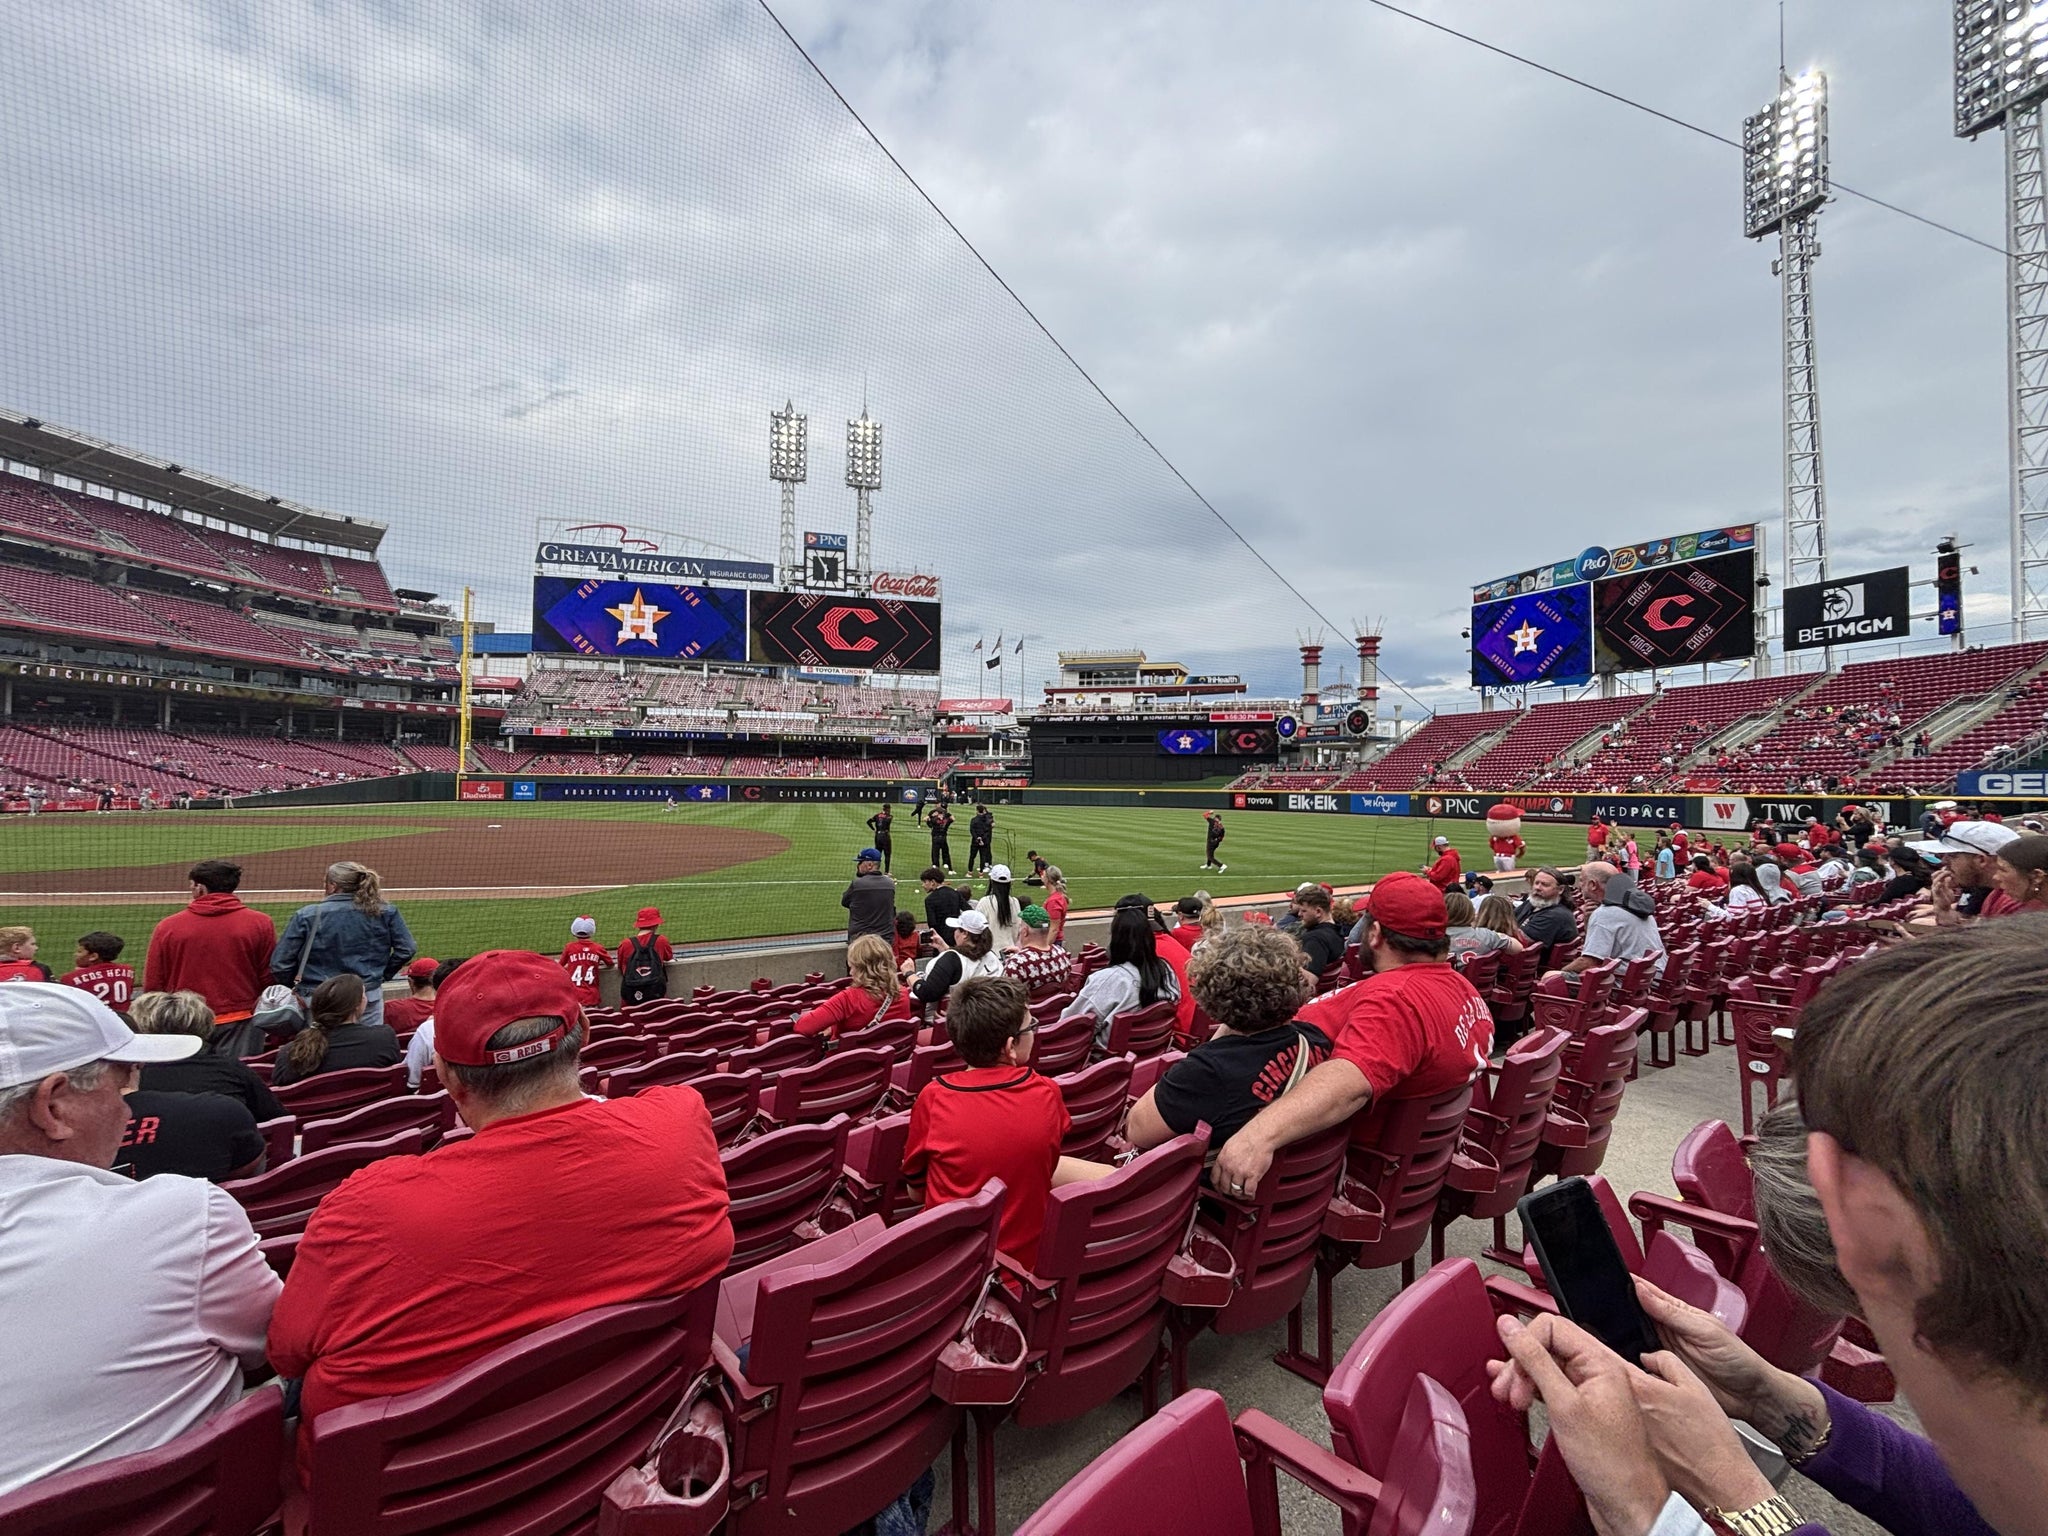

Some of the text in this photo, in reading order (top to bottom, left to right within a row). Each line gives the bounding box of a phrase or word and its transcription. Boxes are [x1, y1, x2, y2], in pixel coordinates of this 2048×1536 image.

[820, 535, 846, 547] PNC
[541, 544, 611, 564] GREAT
[710, 570, 746, 578] INSURANCE
[748, 572, 770, 580] GROUP
[1581, 555, 1608, 572] P&G
[1614, 553, 1635, 569] Tide
[872, 572, 940, 597] Coca-Cola
[1799, 616, 1893, 643] BETMGM
[20, 664, 214, 693] CINCINNATI REDS
[1485, 684, 1525, 696] BEACON
[1332, 704, 1353, 713] PNC
[1978, 773, 2048, 795] GE
[1247, 797, 1273, 805] TOYOTA
[1373, 796, 1397, 813] Kroger
[1445, 798, 1480, 814] PNC
[1596, 804, 1676, 818] MEDPACE
[1761, 803, 1813, 822] TWC
[73, 971, 104, 985] REDS
[571, 965, 595, 986] 44
[93, 980, 127, 1004] 20
[517, 1043, 543, 1058] REDS
